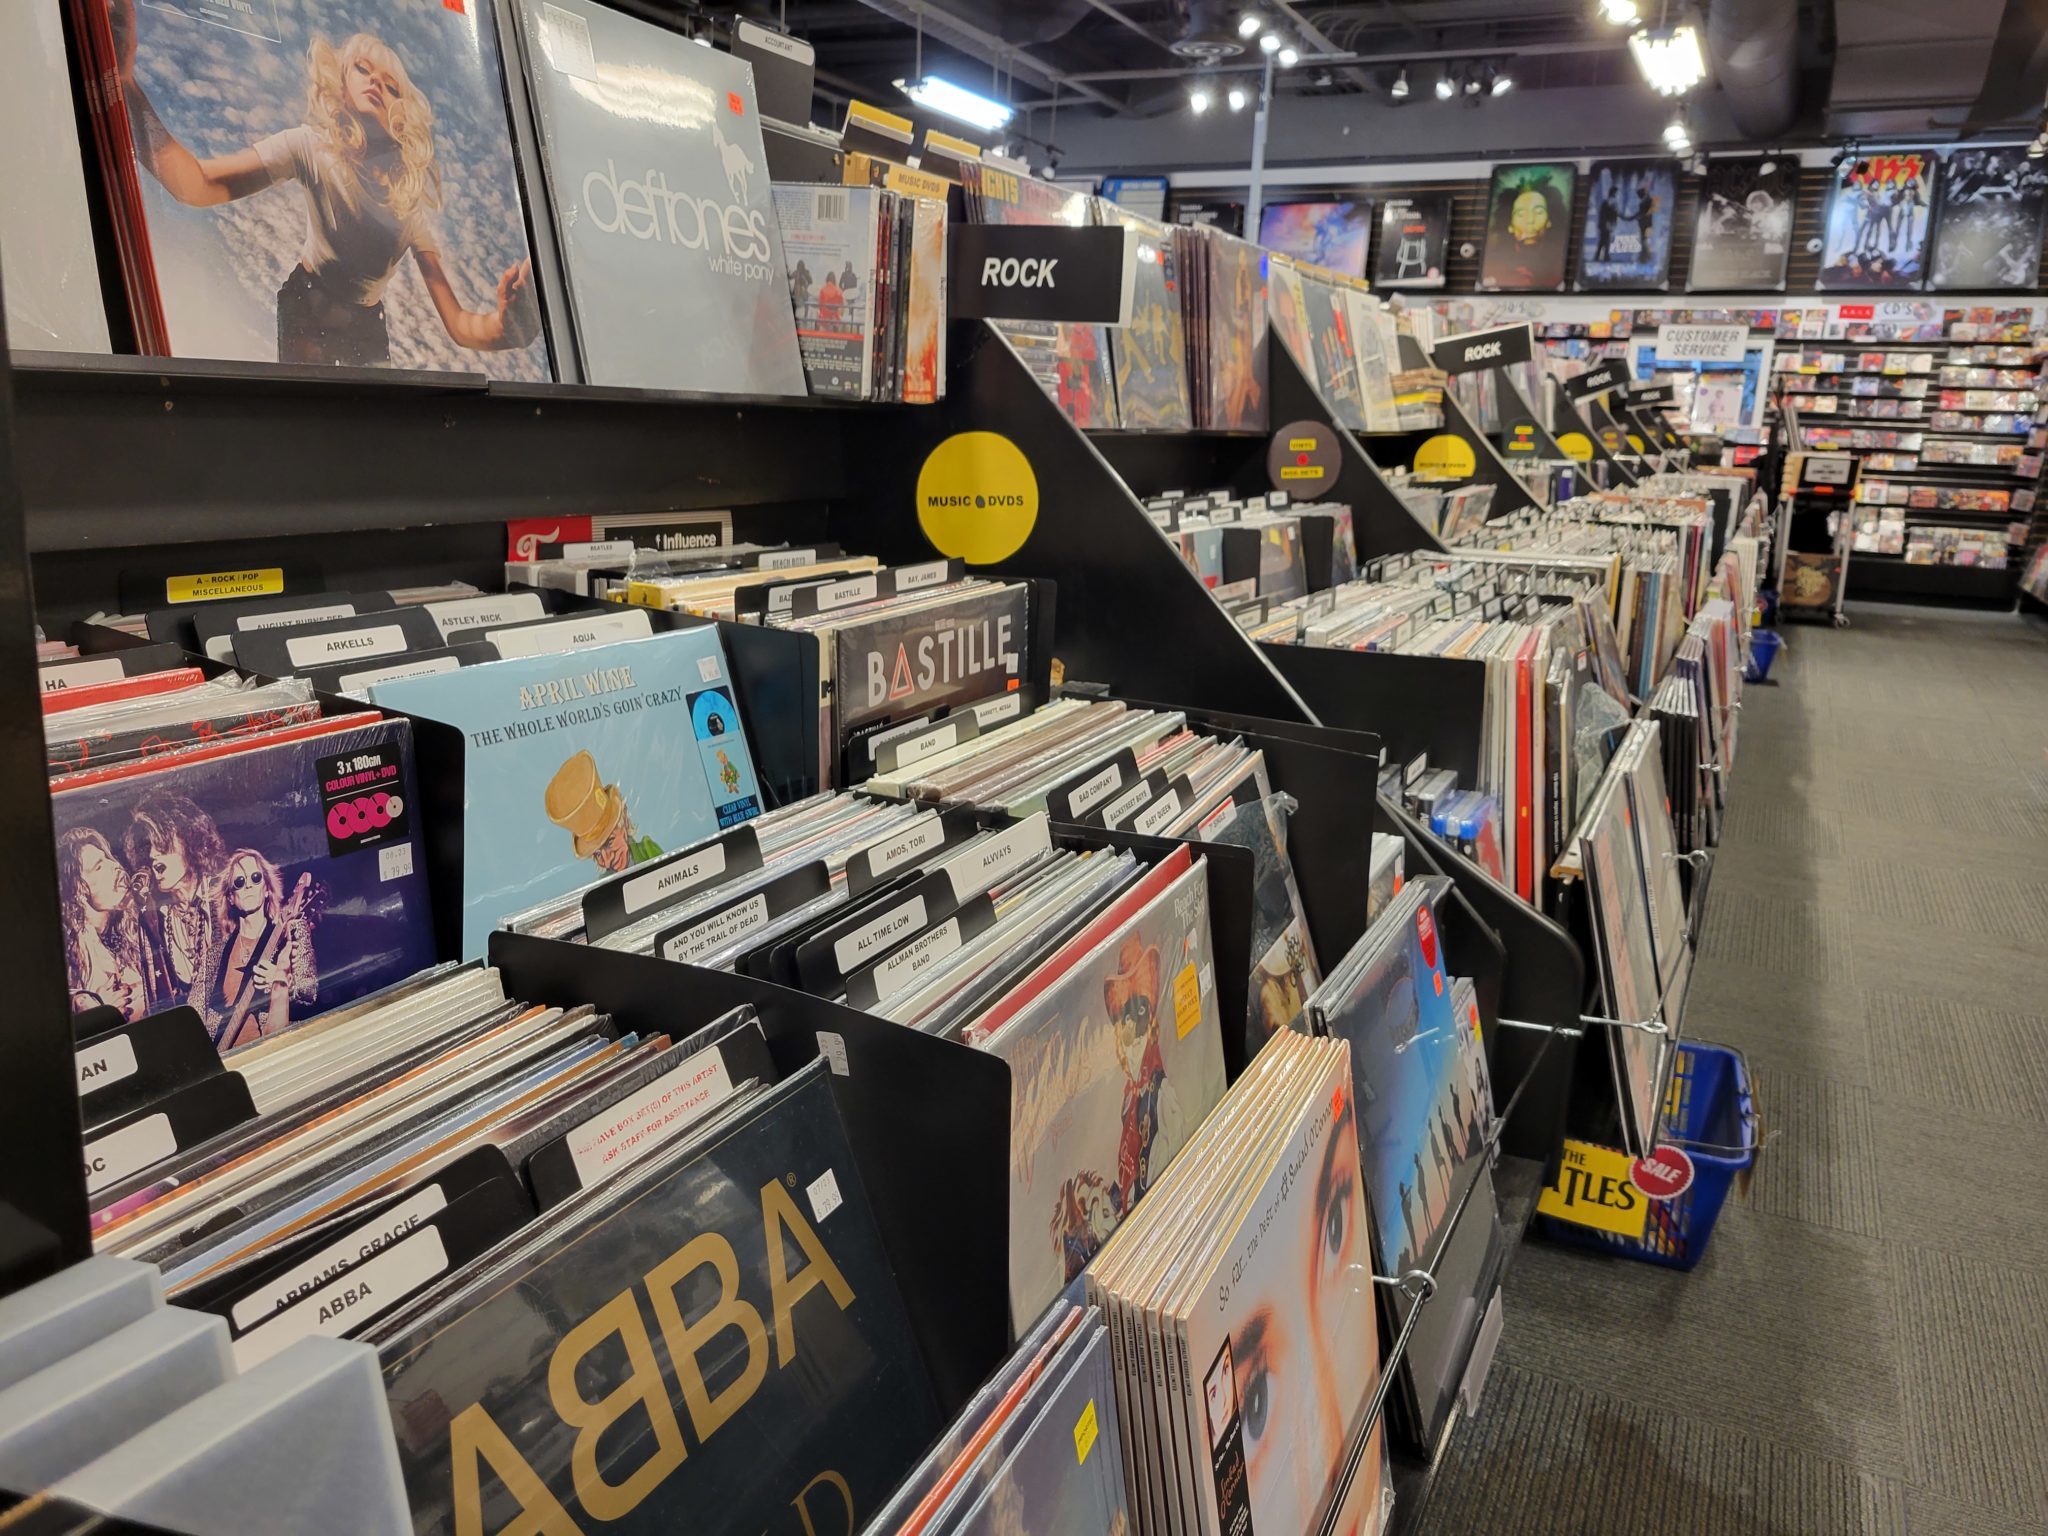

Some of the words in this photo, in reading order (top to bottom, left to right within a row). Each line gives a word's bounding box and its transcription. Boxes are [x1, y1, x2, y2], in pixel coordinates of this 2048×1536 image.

[899, 173, 921, 188] MUSIC
[583, 159, 771, 262] deftones
[709, 255, 742, 277] white
[744, 261, 774, 286] pony
[982, 257, 1058, 288] ROCK
[1666, 330, 1740, 343] CUSTOMER
[1464, 341, 1502, 363] ROCK
[1673, 343, 1728, 356] SERVICE
[928, 495, 972, 508] MUSIC
[988, 494, 1024, 508] DVDS
[663, 532, 717, 549] Influence
[193, 584, 264, 596] MISCELLANEOUS
[211, 574, 235, 584] ROCK
[835, 588, 861, 601] BASTILLE
[442, 615, 480, 627] ASTLEY,
[481, 613, 502, 623] RICK
[327, 637, 374, 652] ARKELLS
[572, 632, 596, 643] AQUA
[519, 677, 585, 712] APRIL
[583, 665, 638, 697] WINE
[470, 729, 503, 748] THE
[503, 716, 555, 740] WHOLE
[555, 701, 611, 729] WORLD'S
[920, 738, 936, 751] BAND
[325, 775, 356, 792] COLOUR
[355, 770, 377, 783] VINYL
[381, 765, 397, 778] DVD
[337, 761, 345, 775] 3
[1079, 791, 1089, 803] BAD
[1090, 776, 1113, 796] COMPANY
[1157, 803, 1172, 820] QUEEN
[909, 834, 926, 849] TORI
[982, 845, 1012, 867] ALVVAYS
[658, 864, 699, 890] ANIMALS
[673, 935, 689, 950] AND
[690, 926, 706, 941] YOU
[706, 916, 724, 934] WILL
[726, 906, 749, 922] KNOW
[750, 900, 759, 913] US
[857, 936, 874, 951] ALL
[873, 924, 892, 943] TIME
[893, 914, 910, 932] LOW
[678, 949, 688, 962] BY
[689, 941, 705, 956] THE
[706, 930, 728, 949] TRAIL
[729, 924, 739, 937] OF
[740, 914, 759, 931] DEAD
[887, 947, 914, 971] ALLMAN
[914, 926, 948, 956] BROTHERS
[912, 954, 930, 971] BAND
[617, 1116, 634, 1132] BOX
[661, 1093, 672, 1103] OF
[673, 1081, 692, 1097] THIS
[693, 1064, 718, 1085] ARTIST
[1640, 1158, 1682, 1184] SALE
[1560, 1165, 1636, 1211] TLES
[318, 1281, 372, 1325] ABBA
